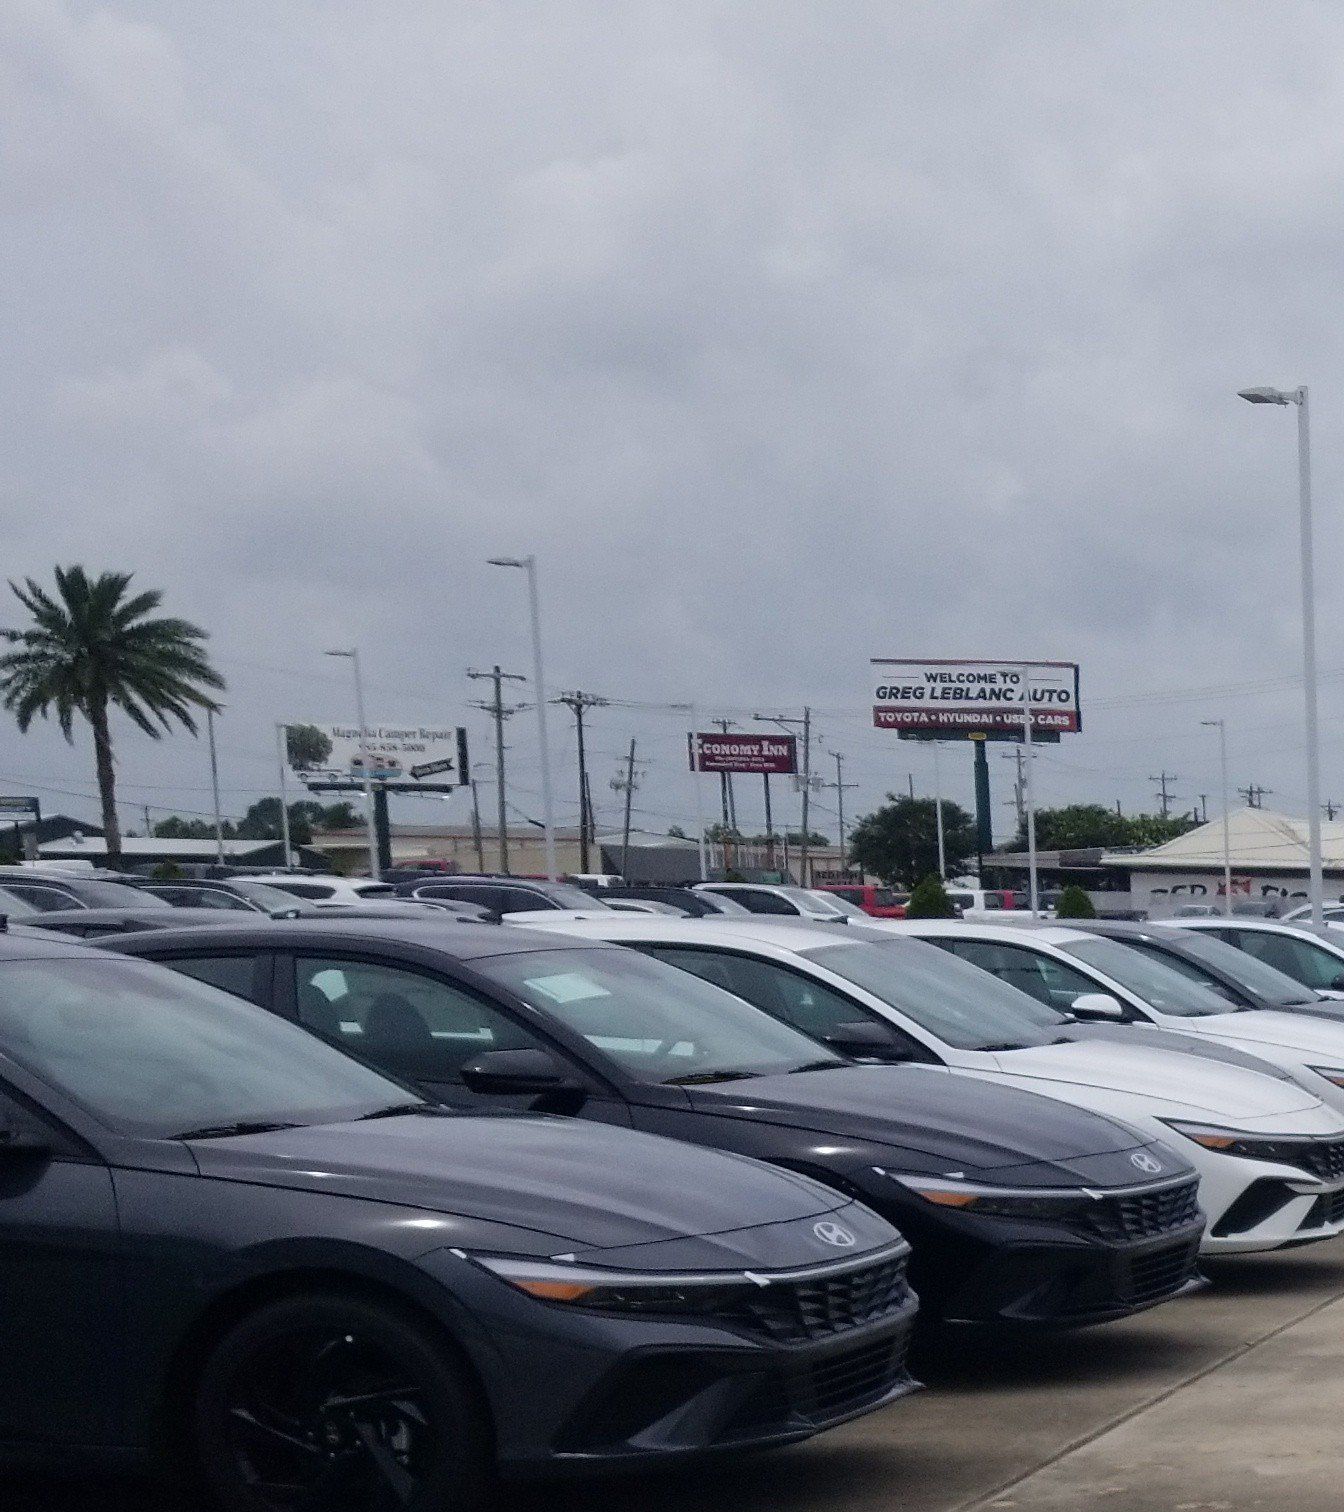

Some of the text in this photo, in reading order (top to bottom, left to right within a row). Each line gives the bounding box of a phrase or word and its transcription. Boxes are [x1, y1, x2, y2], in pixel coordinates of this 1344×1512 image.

[924, 672, 1020, 685] WELCOME TO
[876, 686, 1071, 703] GREG LEBLANC AUTO
[878, 712, 929, 723] TOYOTA
[939, 713, 993, 723] HYUNDAI
[1037, 714, 1070, 726] CARS
